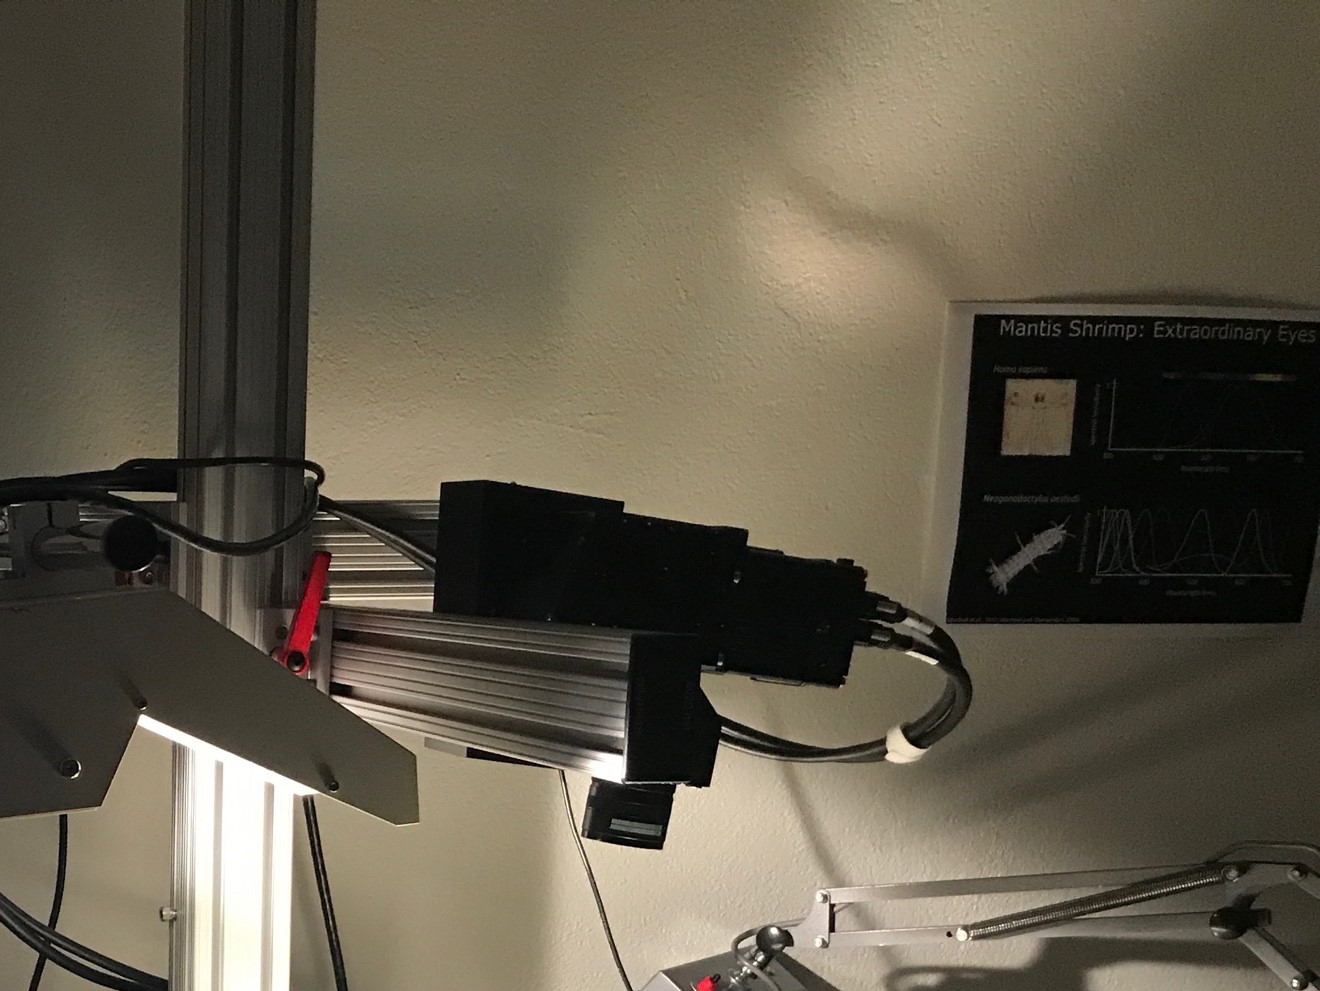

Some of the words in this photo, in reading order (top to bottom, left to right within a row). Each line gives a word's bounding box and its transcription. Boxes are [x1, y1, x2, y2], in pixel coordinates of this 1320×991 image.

[1000, 318, 1062, 338] Mantis
[1069, 320, 1146, 342] Shrimp:
[1153, 321, 1272, 345] Extraordinary
[1278, 325, 1317, 346] Eyes
